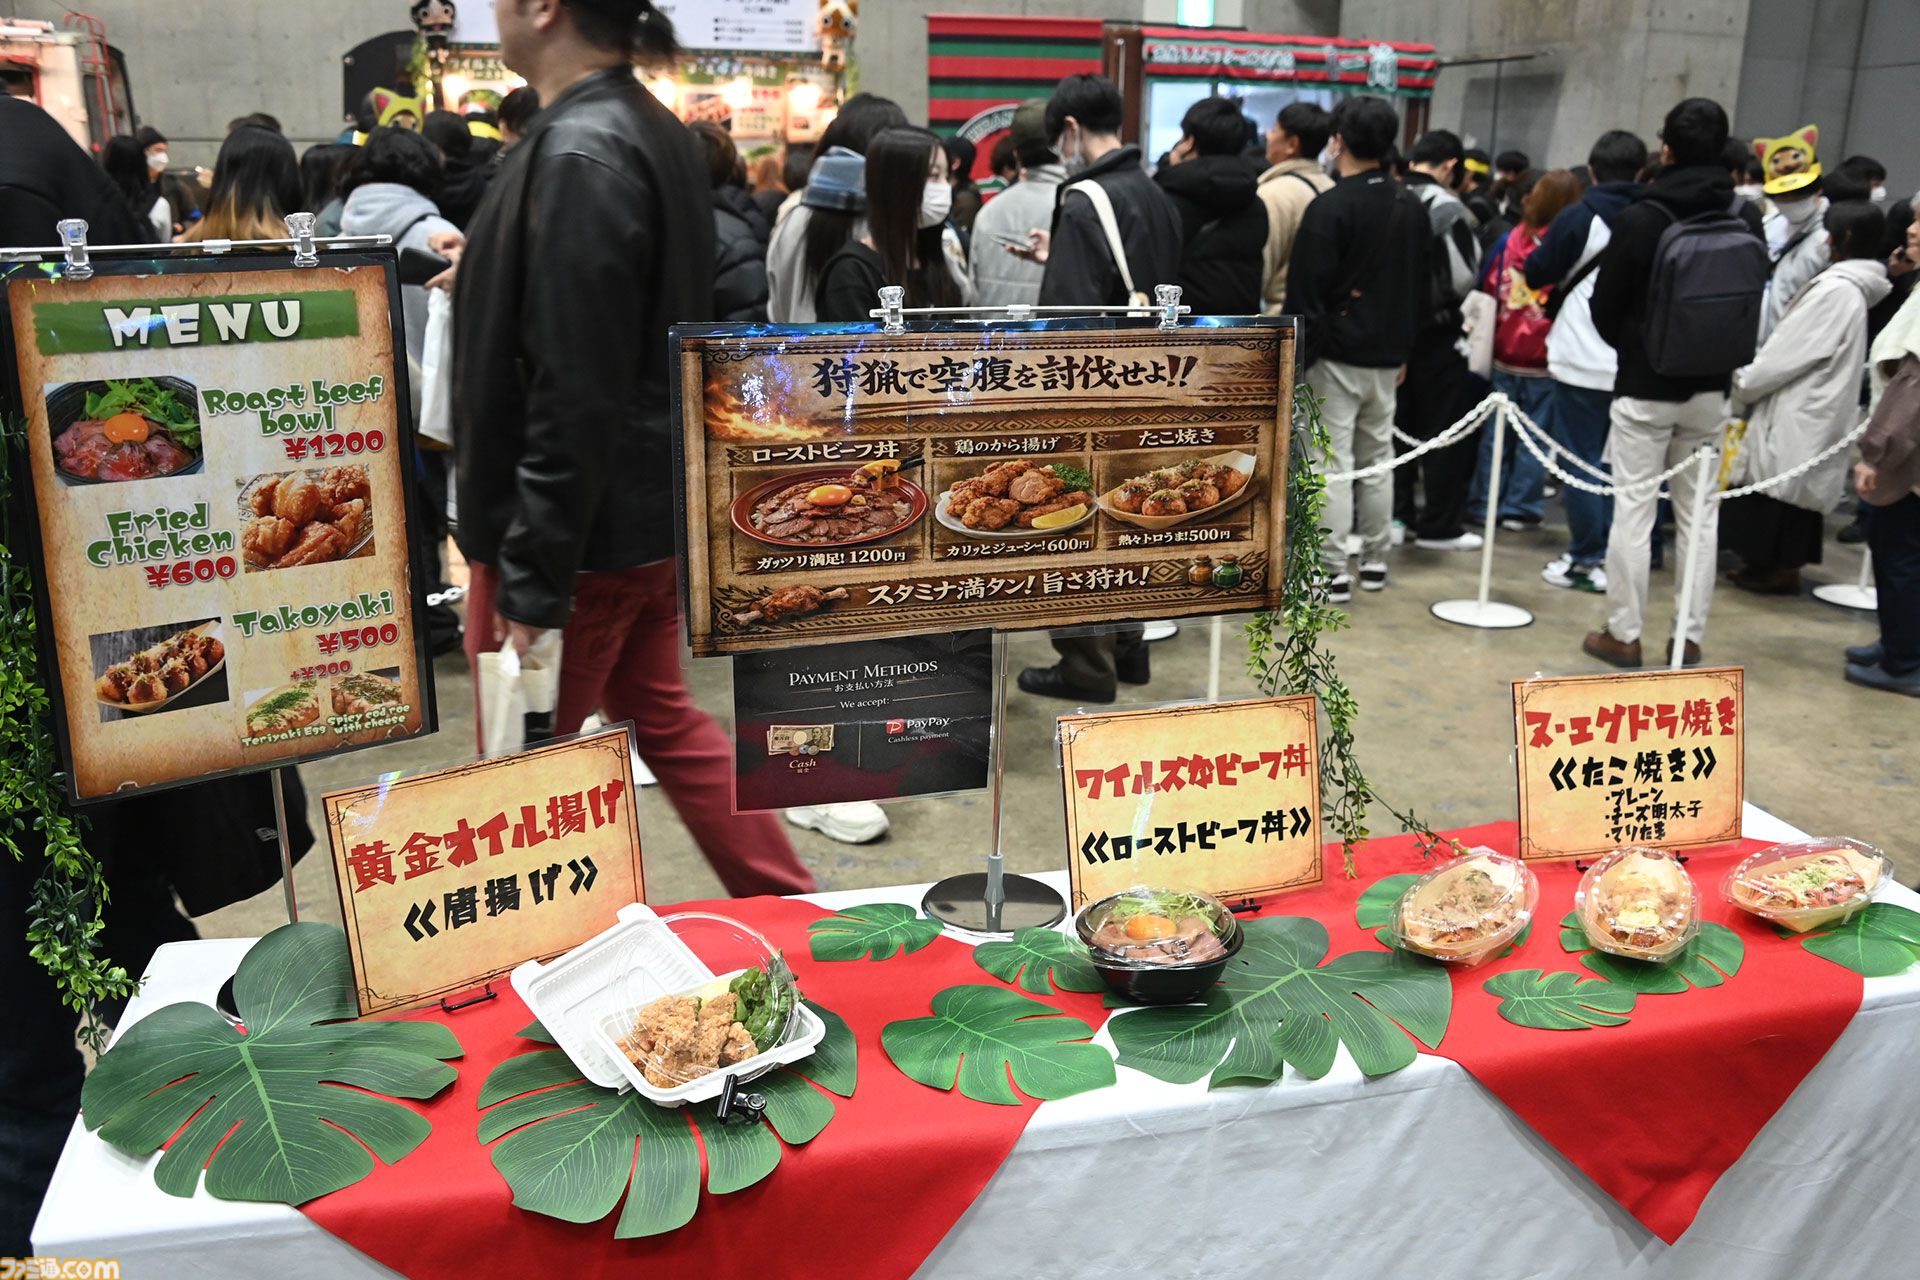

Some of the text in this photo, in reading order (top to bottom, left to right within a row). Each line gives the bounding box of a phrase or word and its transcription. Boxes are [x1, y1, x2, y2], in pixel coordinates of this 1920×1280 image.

[103, 300, 301, 347] MENU
[201, 375, 384, 416] Roast beef
[259, 404, 335, 436] bowl
[282, 430, 386, 462] ¥1200
[953, 436, 1062, 455] 鶏のから揚げ
[1138, 428, 1216, 447] たこ焼き
[752, 440, 900, 463] ローストビーフ丼
[105, 501, 210, 538] Fried
[86, 526, 235, 568] Chicken
[143, 554, 238, 589] ¥600
[232, 589, 394, 638] Takoyaki
[315, 622, 400, 655] ¥500
[789, 660, 939, 687] PAYMENT METHODS
[834, 679, 894, 693] お支払い方法
[327, 703, 411, 727] Spicy cod roe
[840, 697, 890, 710] We accept:
[241, 724, 327, 747] Teriyaki Egg
[334, 714, 406, 735] with cheese
[907, 716, 951, 730] PayPay
[887, 731, 950, 744] Cashless payment
[789, 757, 817, 769] Cash
[1075, 742, 1311, 800] ワイルズなビーフ丼
[348, 778, 625, 894] 黄金オイル揚げ
